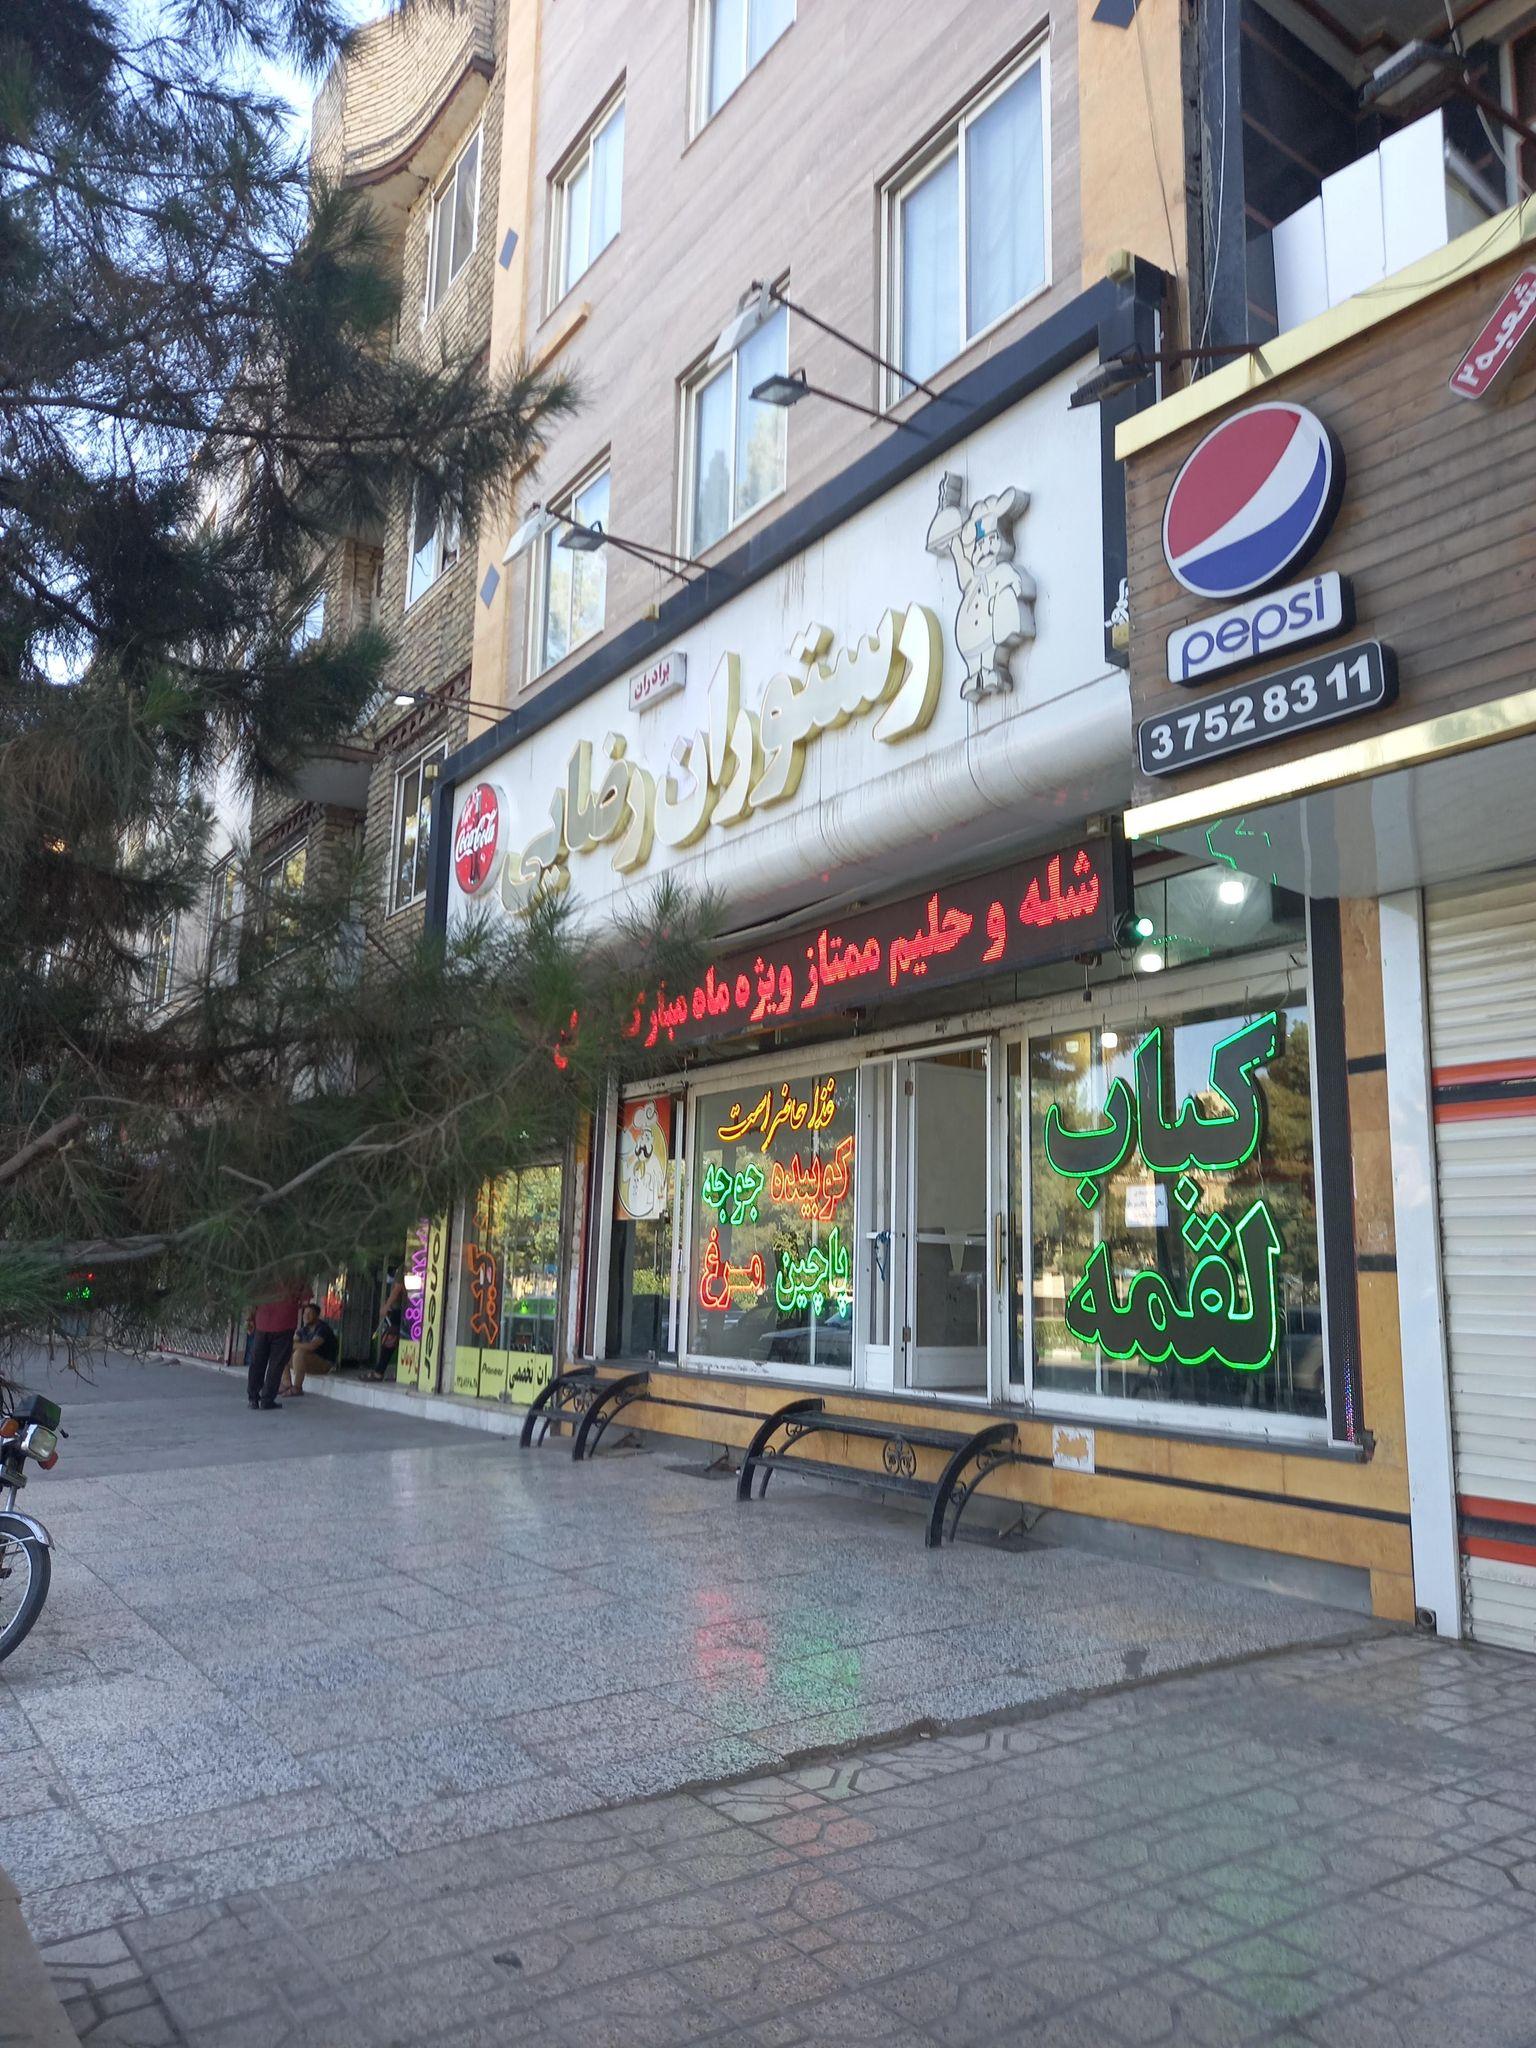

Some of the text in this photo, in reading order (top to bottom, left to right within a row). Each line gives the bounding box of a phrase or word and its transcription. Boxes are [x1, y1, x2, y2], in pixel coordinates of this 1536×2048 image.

[1181, 577, 1325, 679] pepsi
[634, 662, 670, 701] برادران
[500, 602, 943, 914] رستوران رضایی
[1149, 695, 1257, 761] 3752
[1019, 850, 1099, 927] شله
[801, 929, 881, 1009] ممتاز
[889, 893, 974, 987] حلیم
[982, 900, 1007, 963] و
[692, 965, 730, 1020] ماه
[735, 956, 793, 1021] ویژه
[717, 1076, 837, 1152] غذا حاضر است
[1044, 1010, 1278, 1209] کباب
[701, 1135, 855, 1225] کوبیده جوجه
[424, 1210, 445, 1380] ioneer
[700, 1226, 852, 1318] پاچین مرغ
[1066, 1200, 1282, 1370] لقمه
